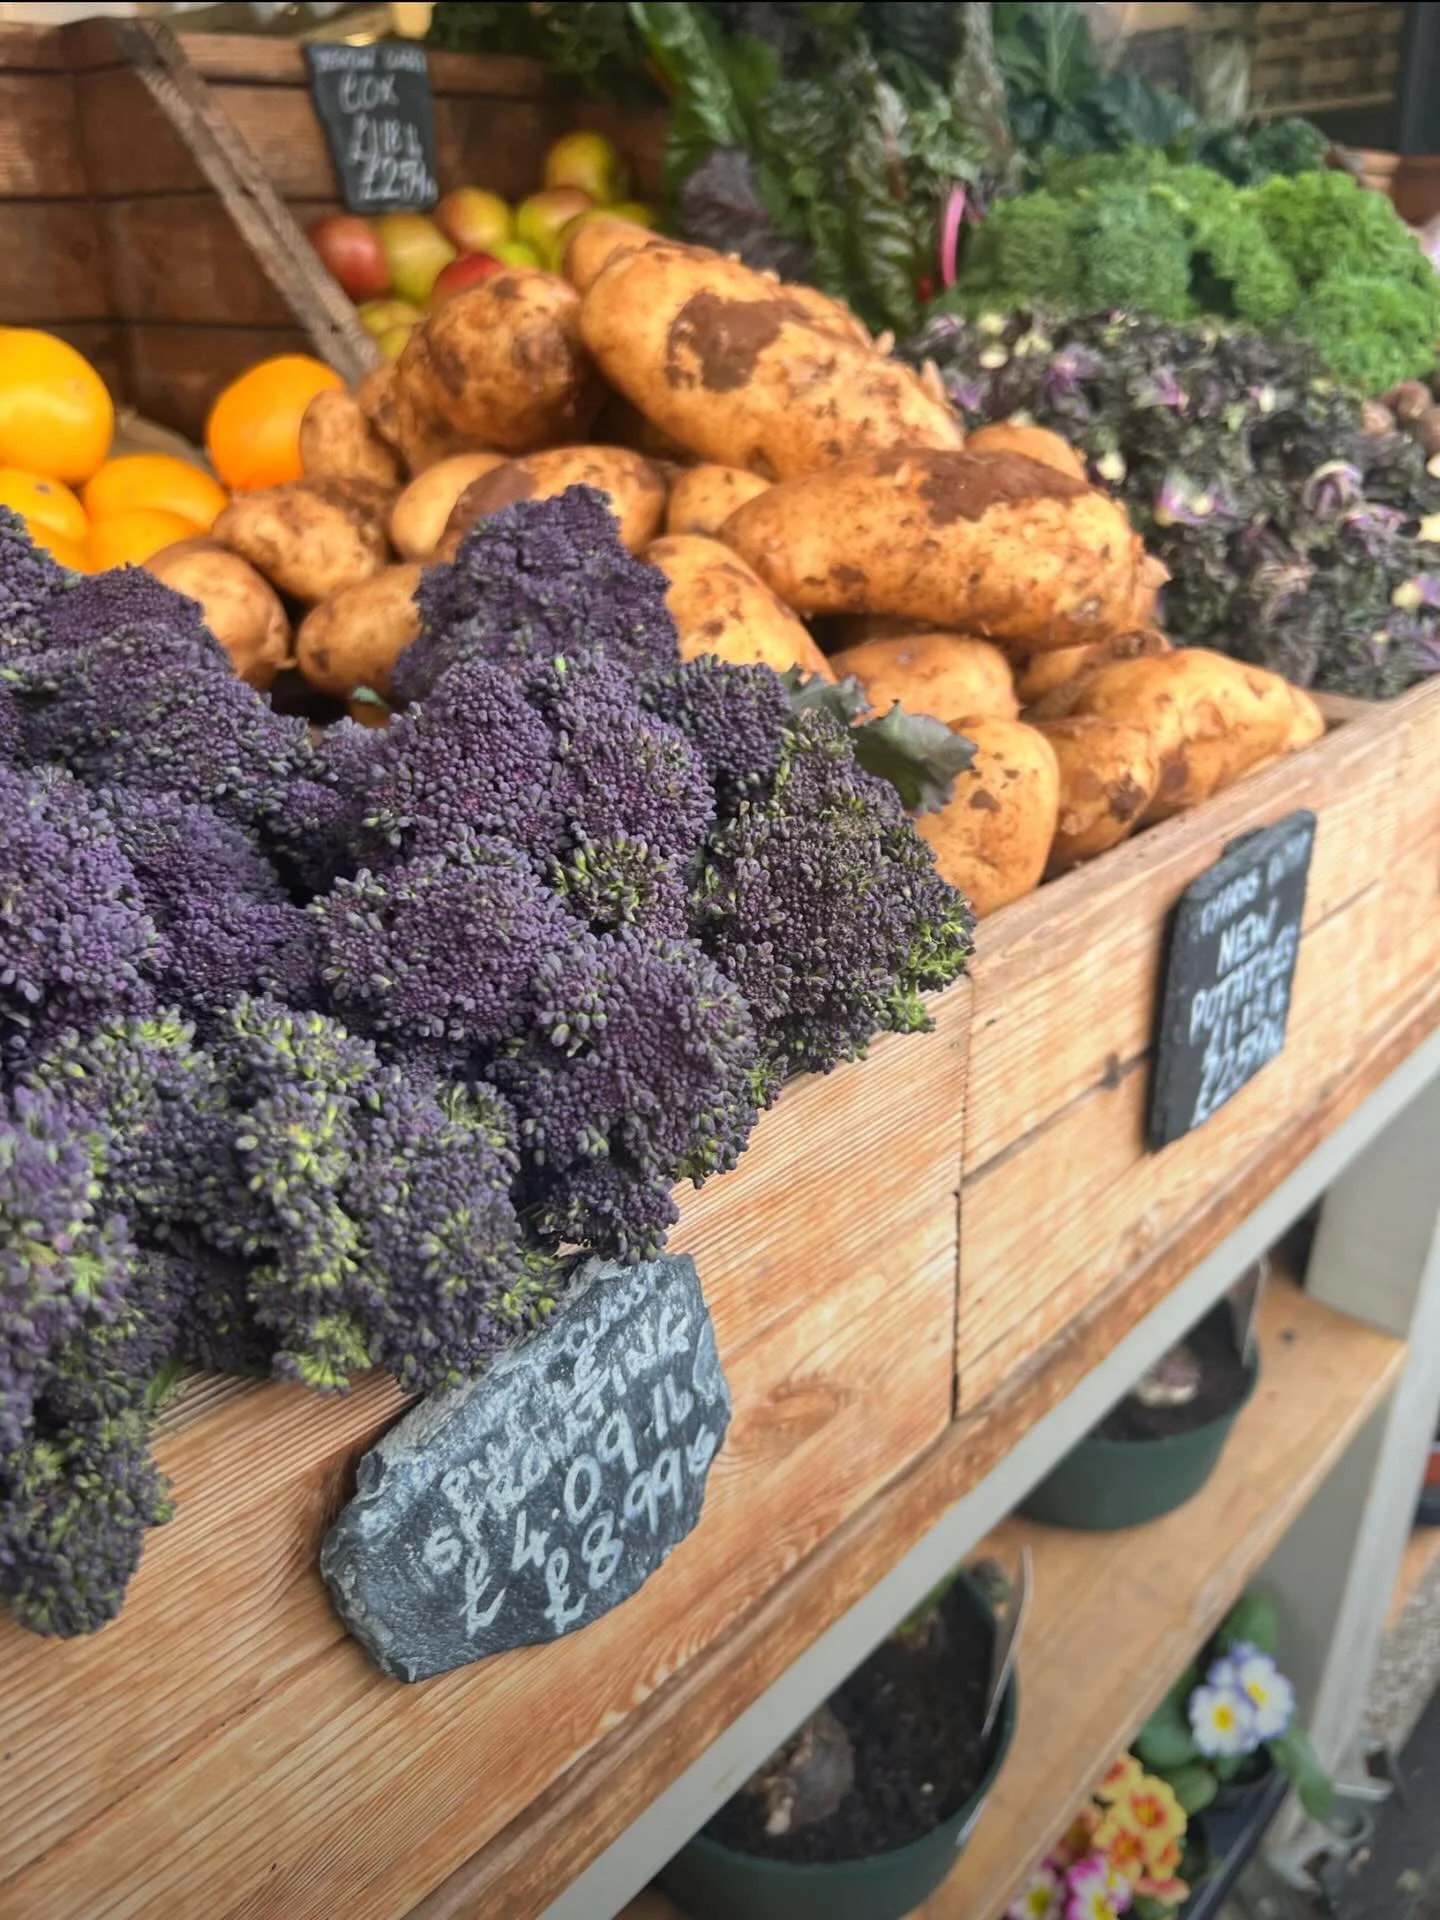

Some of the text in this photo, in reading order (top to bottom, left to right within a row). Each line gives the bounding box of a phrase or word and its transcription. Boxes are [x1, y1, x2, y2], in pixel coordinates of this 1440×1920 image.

[1189, 924, 1298, 1047] POTATOES
[1216, 896, 1279, 977] NEW
[422, 1306, 693, 1576] SPROUTING
